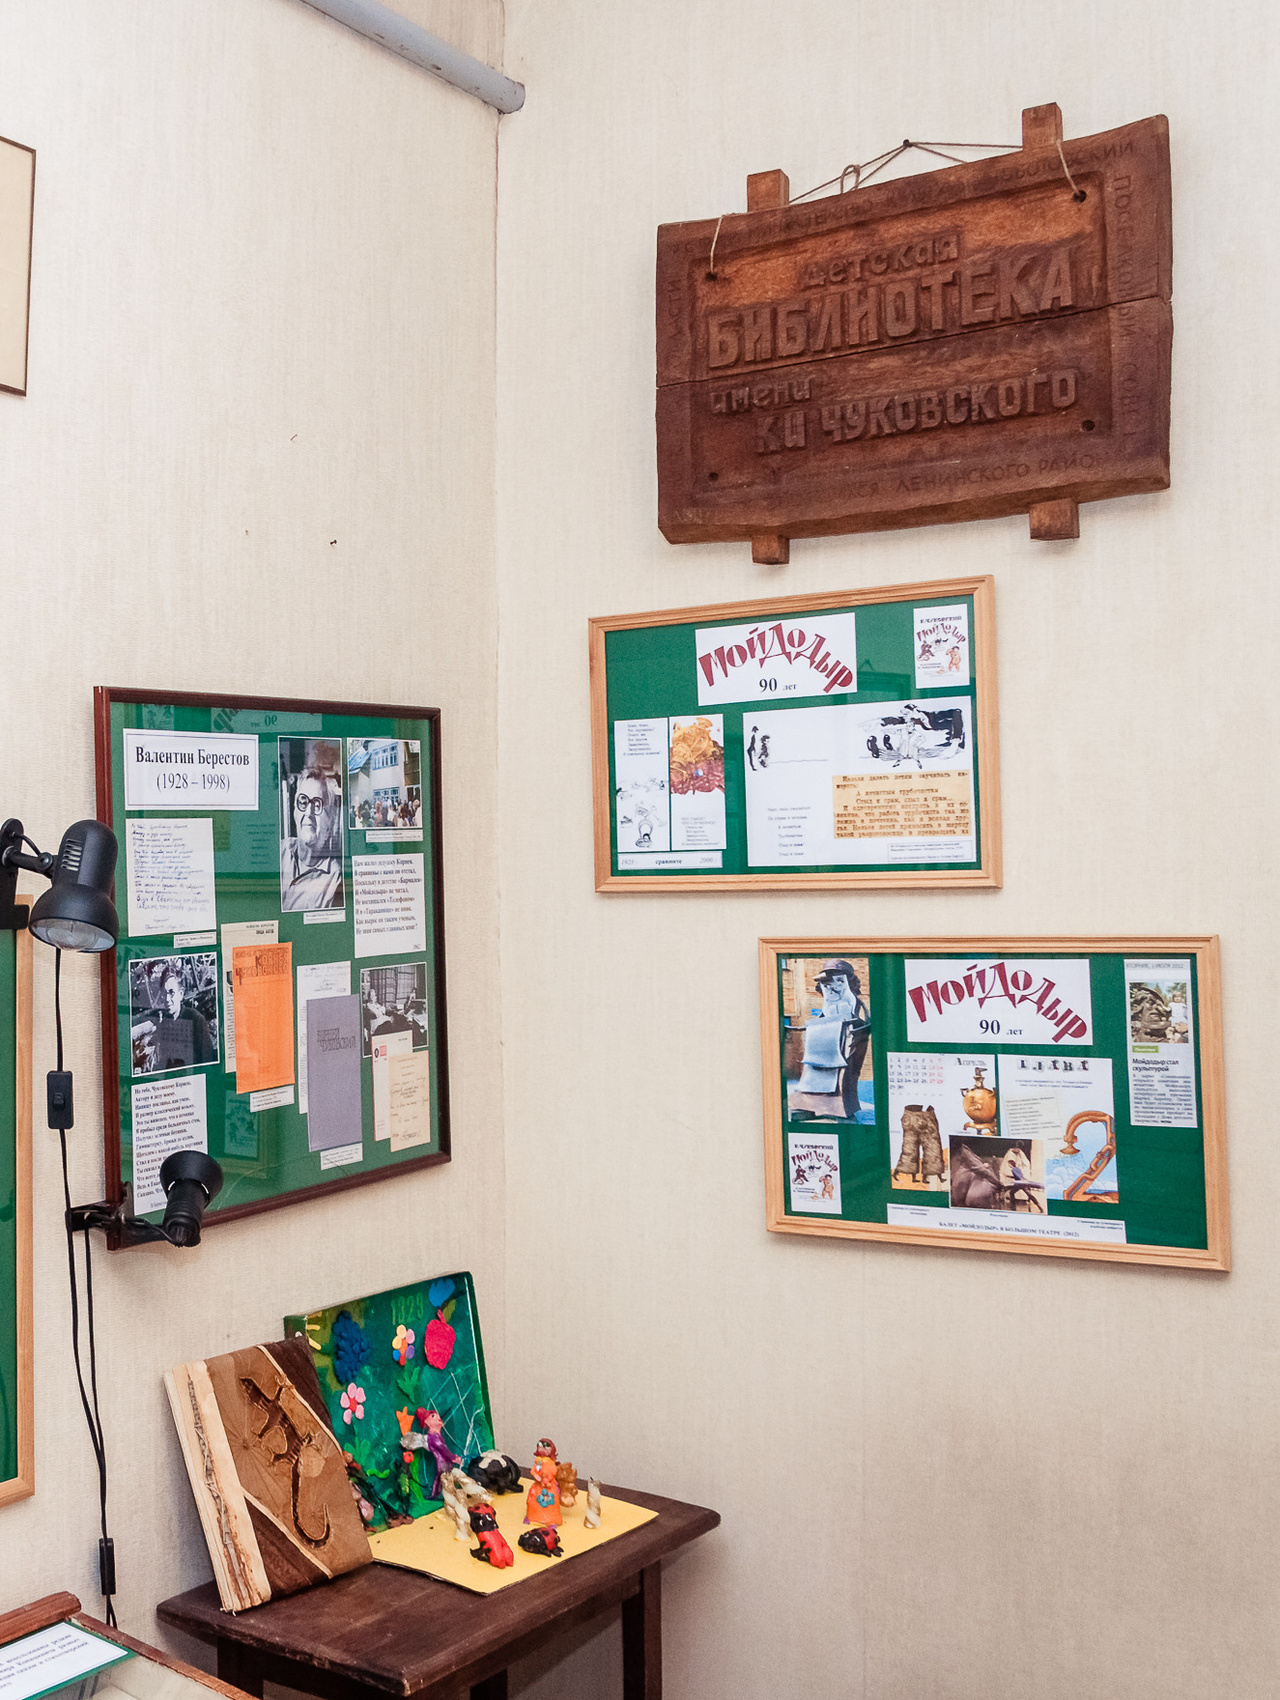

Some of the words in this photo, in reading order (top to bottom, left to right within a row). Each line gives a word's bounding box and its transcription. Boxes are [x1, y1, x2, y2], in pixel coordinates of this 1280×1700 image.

[708, 246, 1075, 370] БИБЛИОТЕКА
[710, 374, 815, 416] имени
[821, 368, 1079, 445] ЧУКОВСКОГО
[896, 461, 1030, 493] ЛЕНИНСКОГО
[759, 678, 778, 692] 90
[782, 683, 797, 691] лет
[135, 746, 194, 764] Валентин
[197, 748, 249, 769] Берестов
[156, 772, 188, 792] (1928
[202, 773, 230, 793] 1998)
[979, 1018, 1002, 1037] 90
[1005, 1026, 1025, 1038] лет
